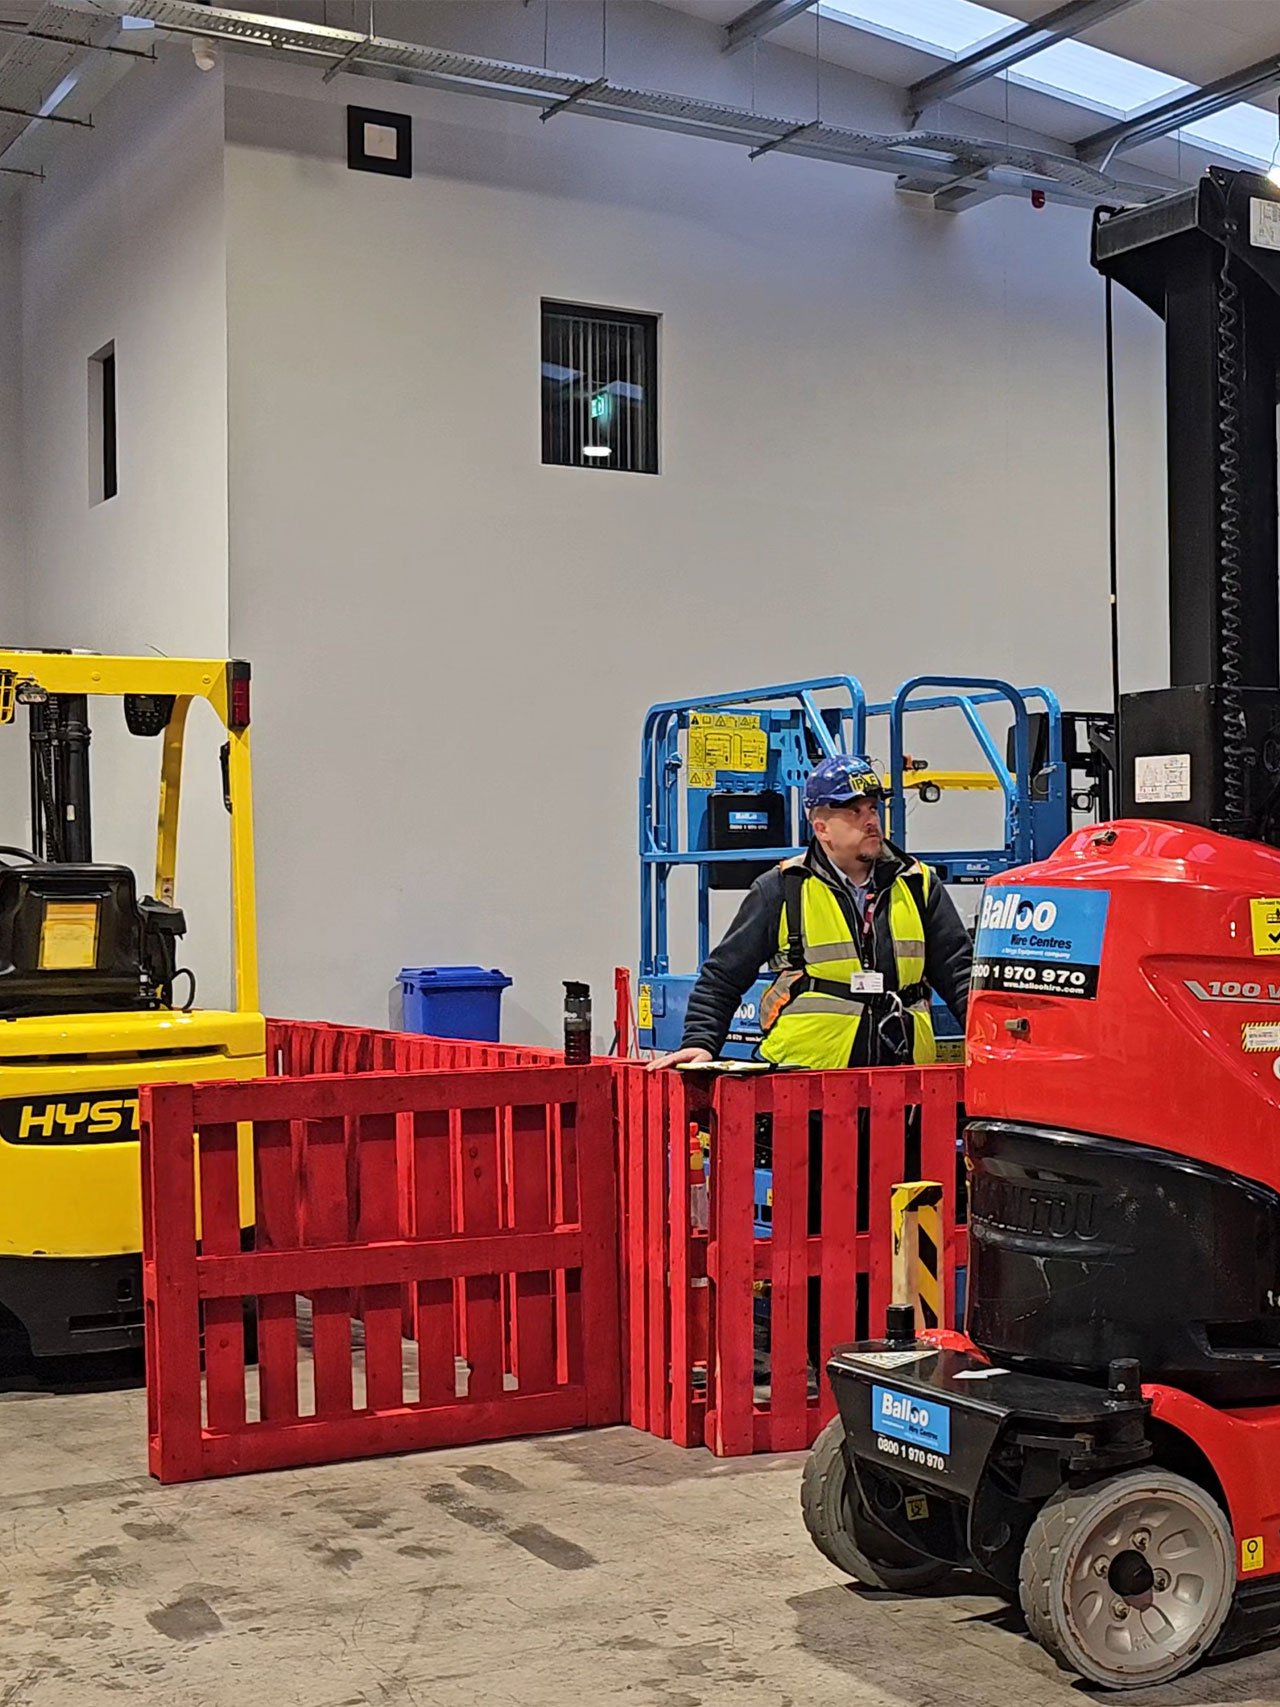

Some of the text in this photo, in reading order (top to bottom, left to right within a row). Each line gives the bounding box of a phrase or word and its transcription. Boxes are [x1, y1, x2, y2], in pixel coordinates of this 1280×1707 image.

[980, 893, 1057, 932] Balloo
[1029, 935, 1072, 950] Centres
[993, 965, 1000, 978] 1
[1004, 966, 1036, 981] 970
[1042, 969, 1086, 985] 970
[1208, 981, 1261, 997] 100
[882, 1392, 929, 1427] Balloo
[877, 1437, 899, 1456] 0800
[901, 1445, 906, 1458] 1
[908, 1447, 925, 1464] 970
[926, 1453, 945, 1471] 970
